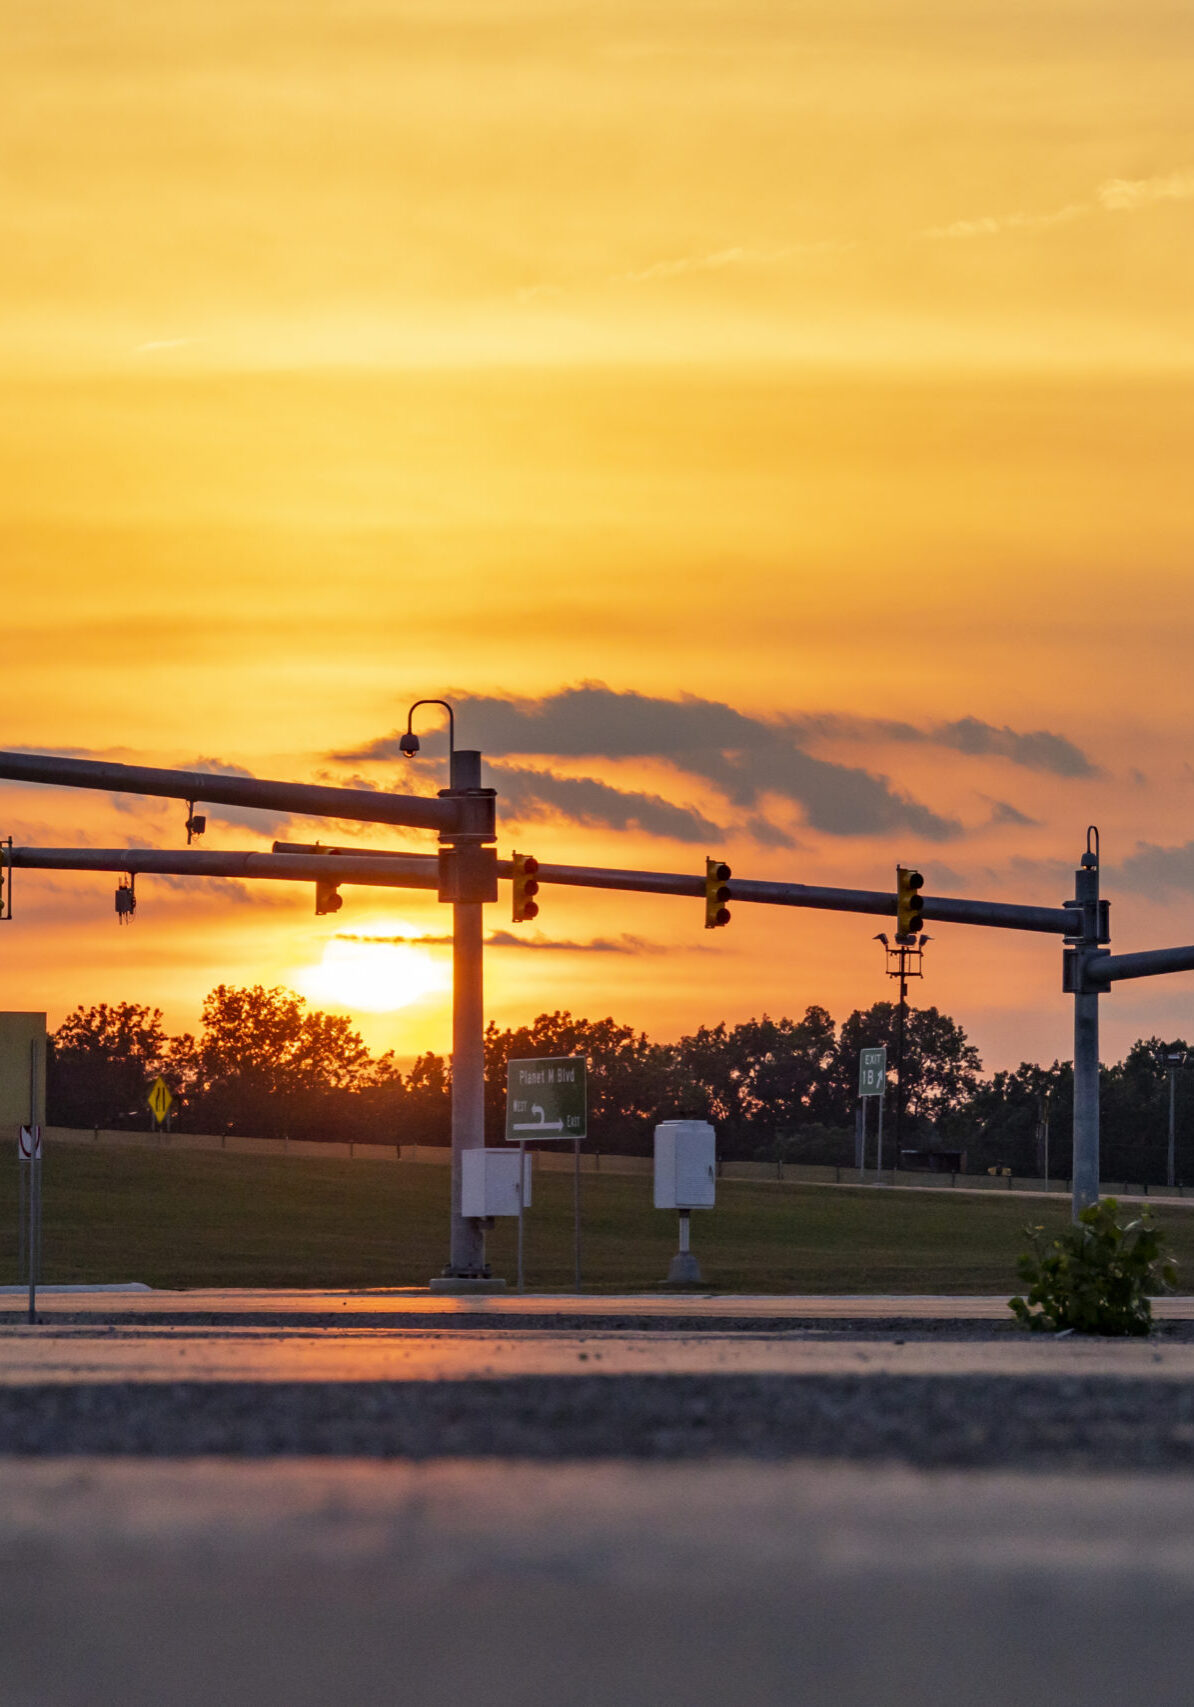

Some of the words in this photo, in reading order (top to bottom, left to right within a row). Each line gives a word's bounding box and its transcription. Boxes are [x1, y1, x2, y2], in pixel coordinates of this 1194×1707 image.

[865, 1054, 881, 1065] EXIT
[519, 1070, 545, 1085] Planet
[557, 1068, 575, 1082] Blvd
